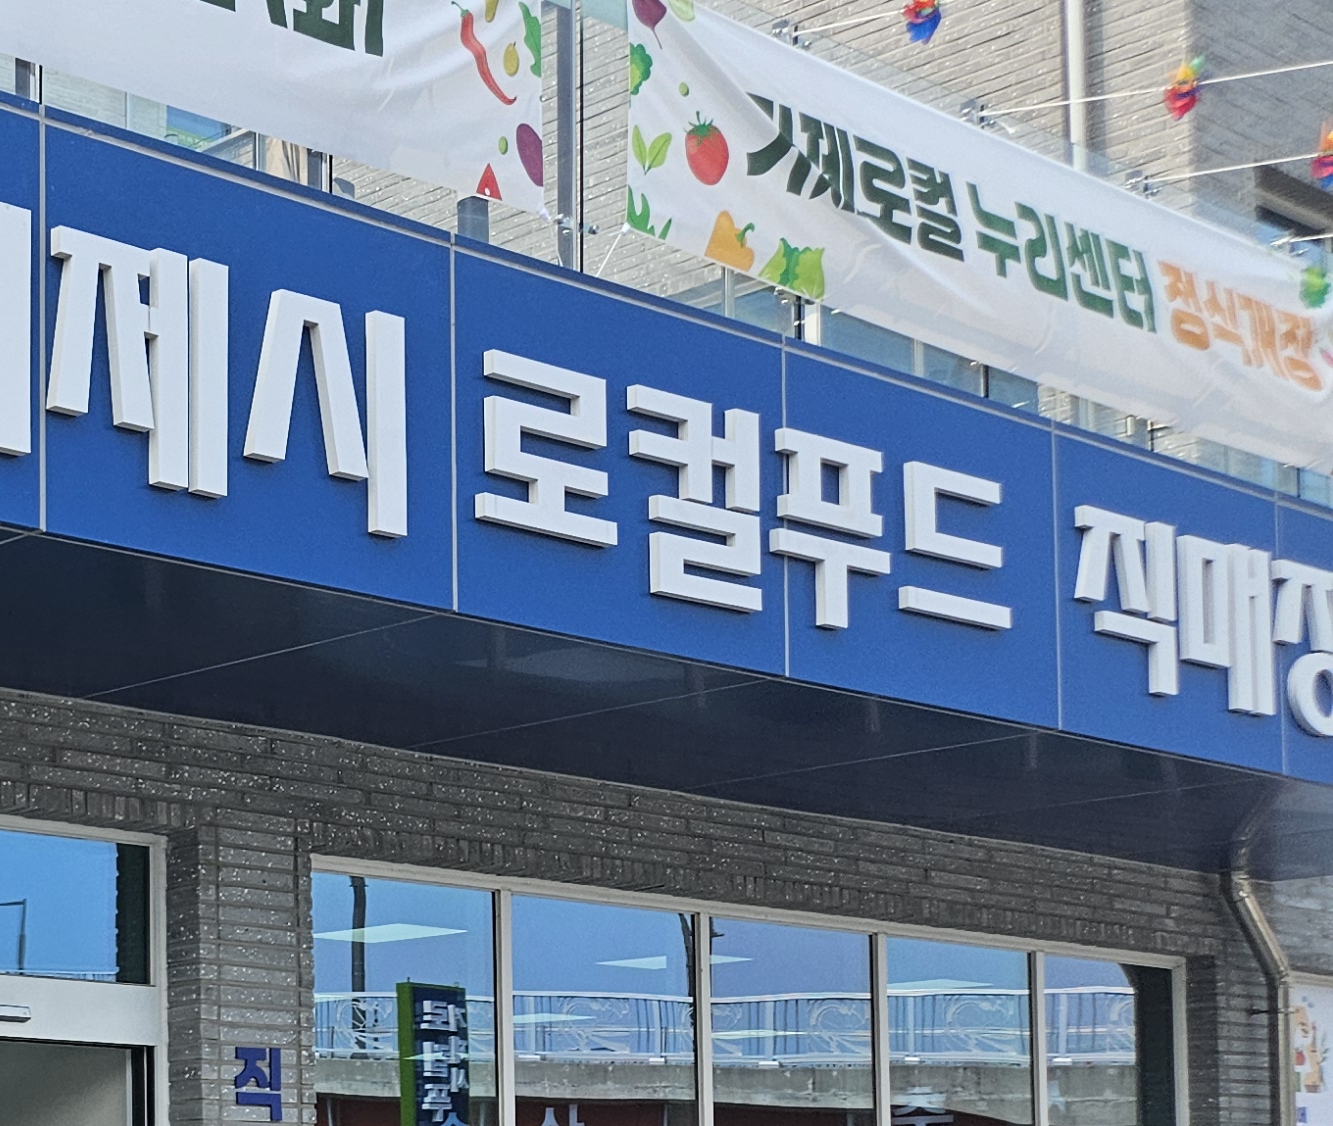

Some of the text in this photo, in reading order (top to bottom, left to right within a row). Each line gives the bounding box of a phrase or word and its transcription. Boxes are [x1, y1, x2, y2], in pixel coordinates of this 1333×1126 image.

[967, 182, 1157, 333] 누리센터
[1159, 259, 1323, 391] 정식개장
[475, 349, 1012, 631] 로컬푸드
